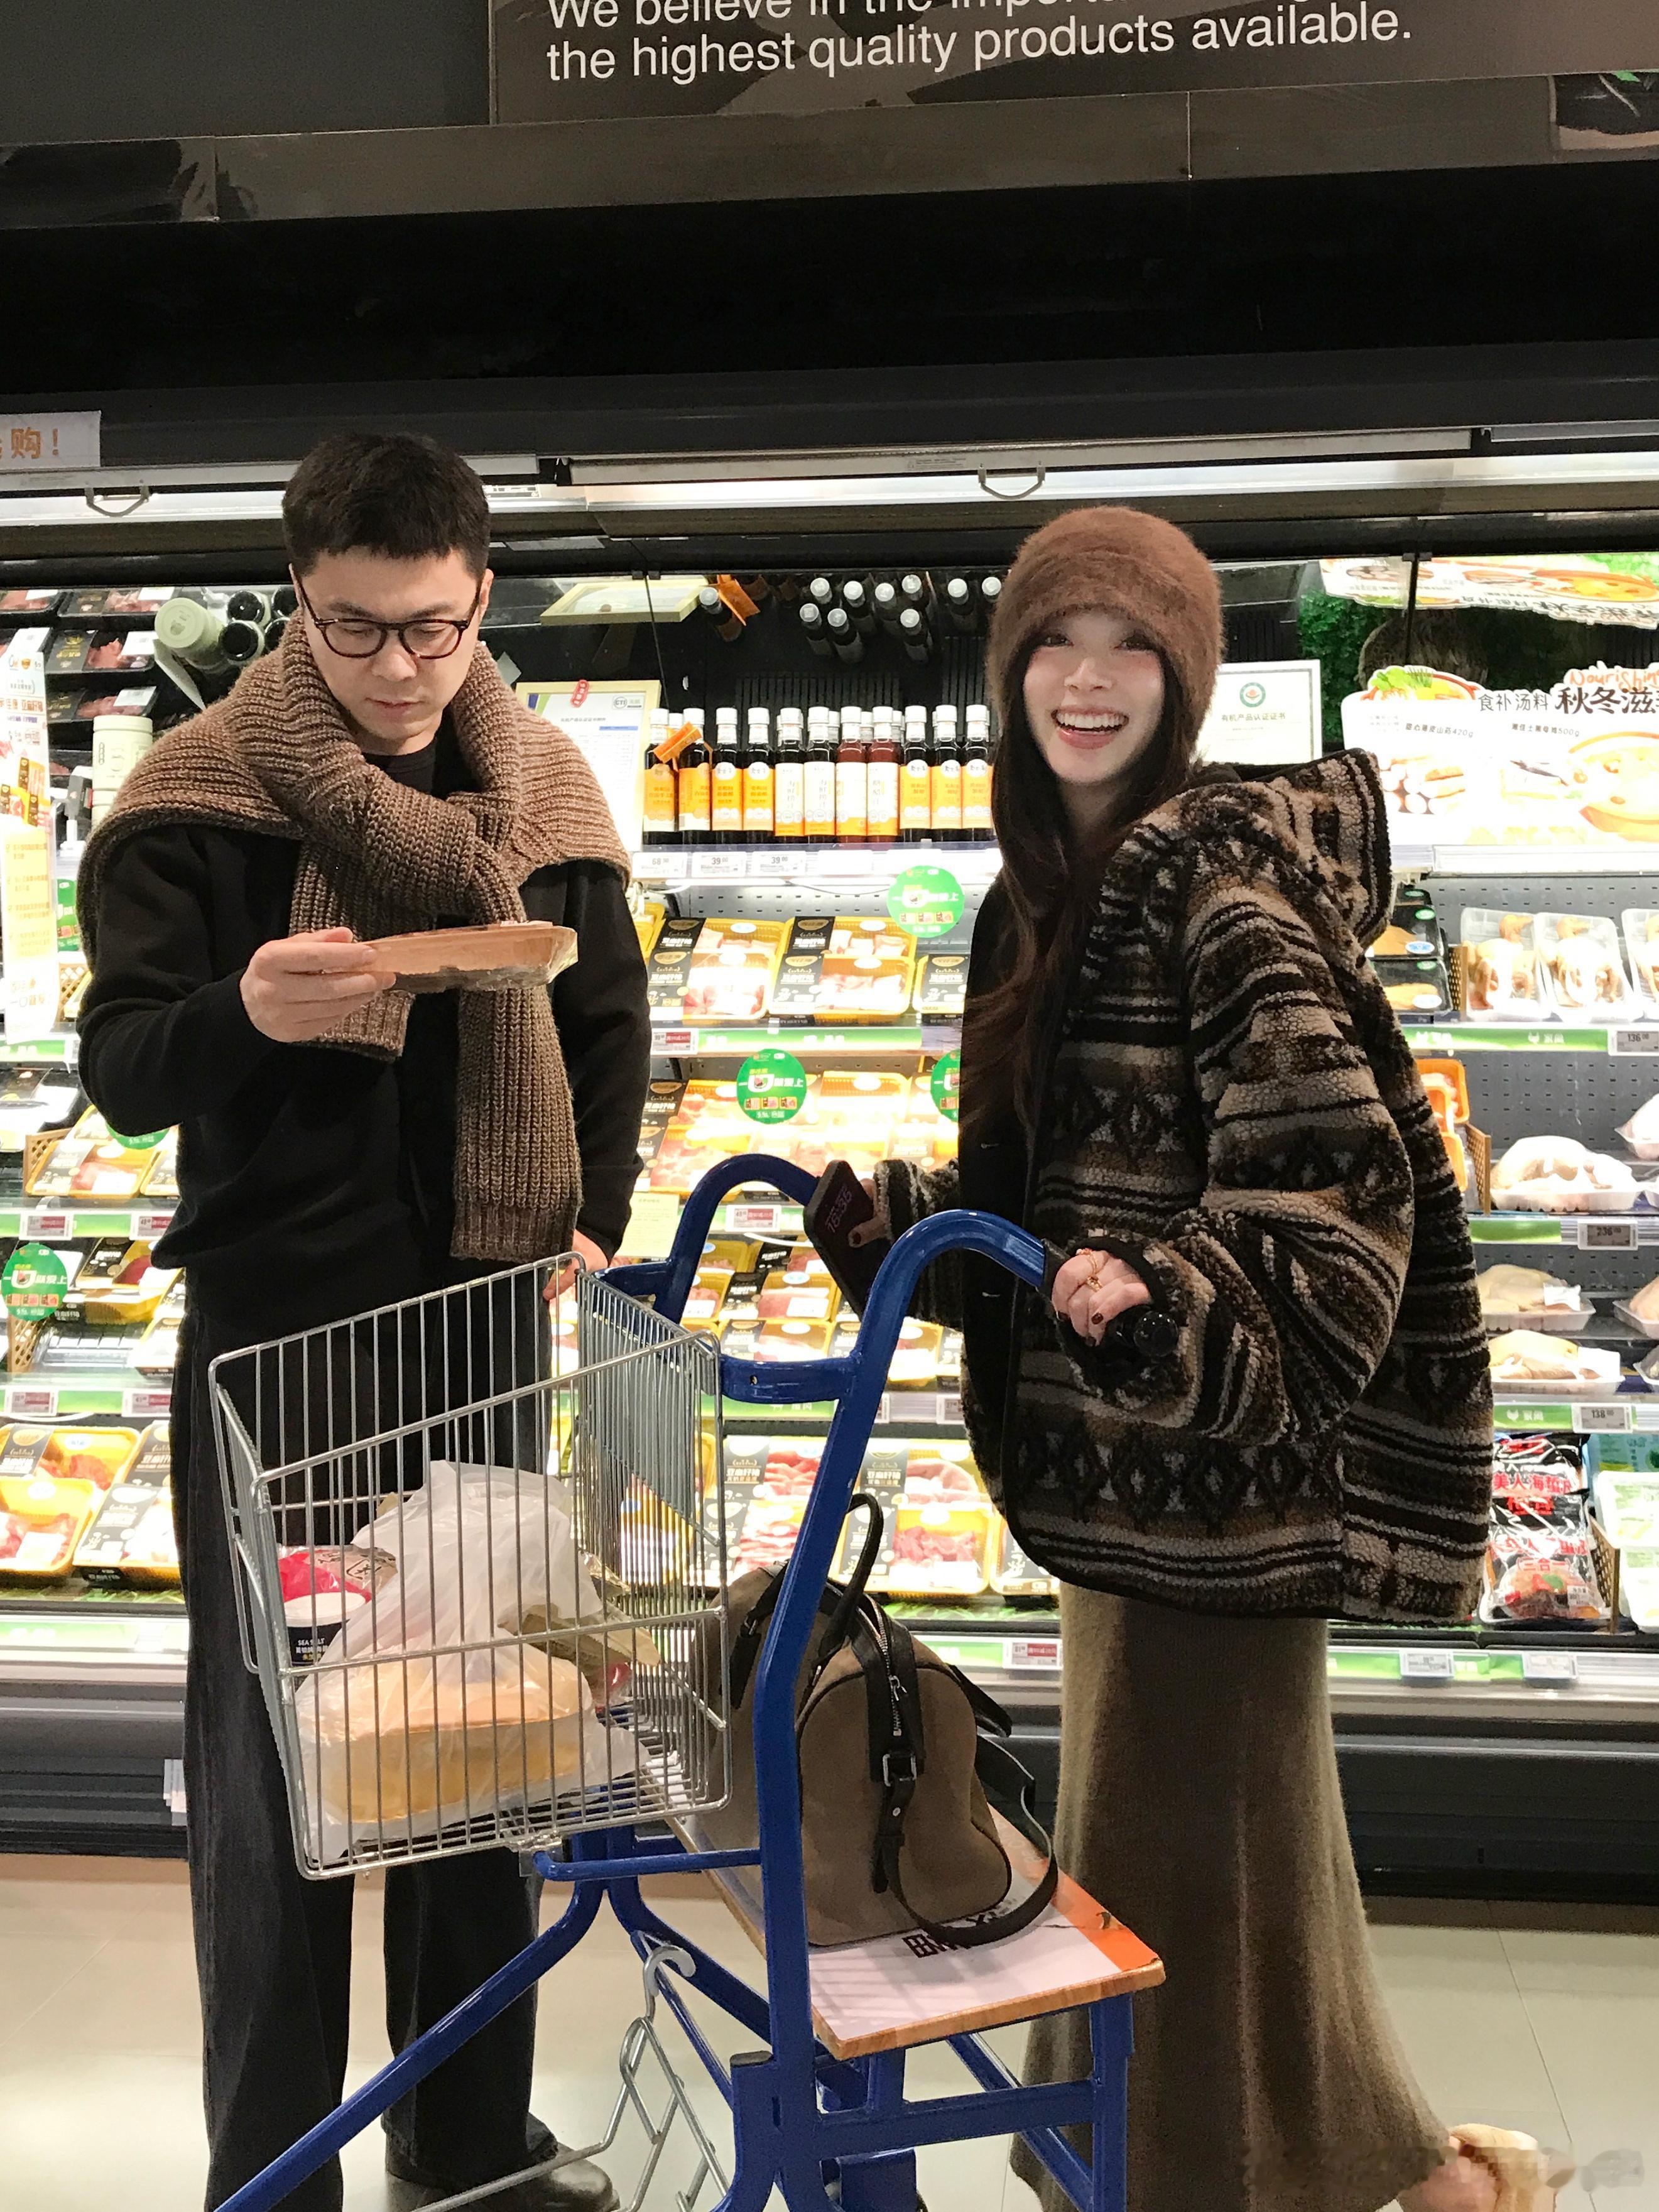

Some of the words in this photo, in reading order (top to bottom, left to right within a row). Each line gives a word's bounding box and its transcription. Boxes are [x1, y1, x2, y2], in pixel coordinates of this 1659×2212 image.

[547, 41, 616, 81] the
[633, 32, 795, 85] highest
[808, 24, 957, 77] quality
[975, 13, 1175, 71] products
[1192, 1, 1412, 50] available.
[1478, 692, 1548, 711] 食补汤料
[1555, 685, 1659, 714] 秋冬滋
[1627, 1033, 1641, 1042] 136
[1596, 1226, 1613, 1236] 236
[1591, 1409, 1606, 1419] 138
